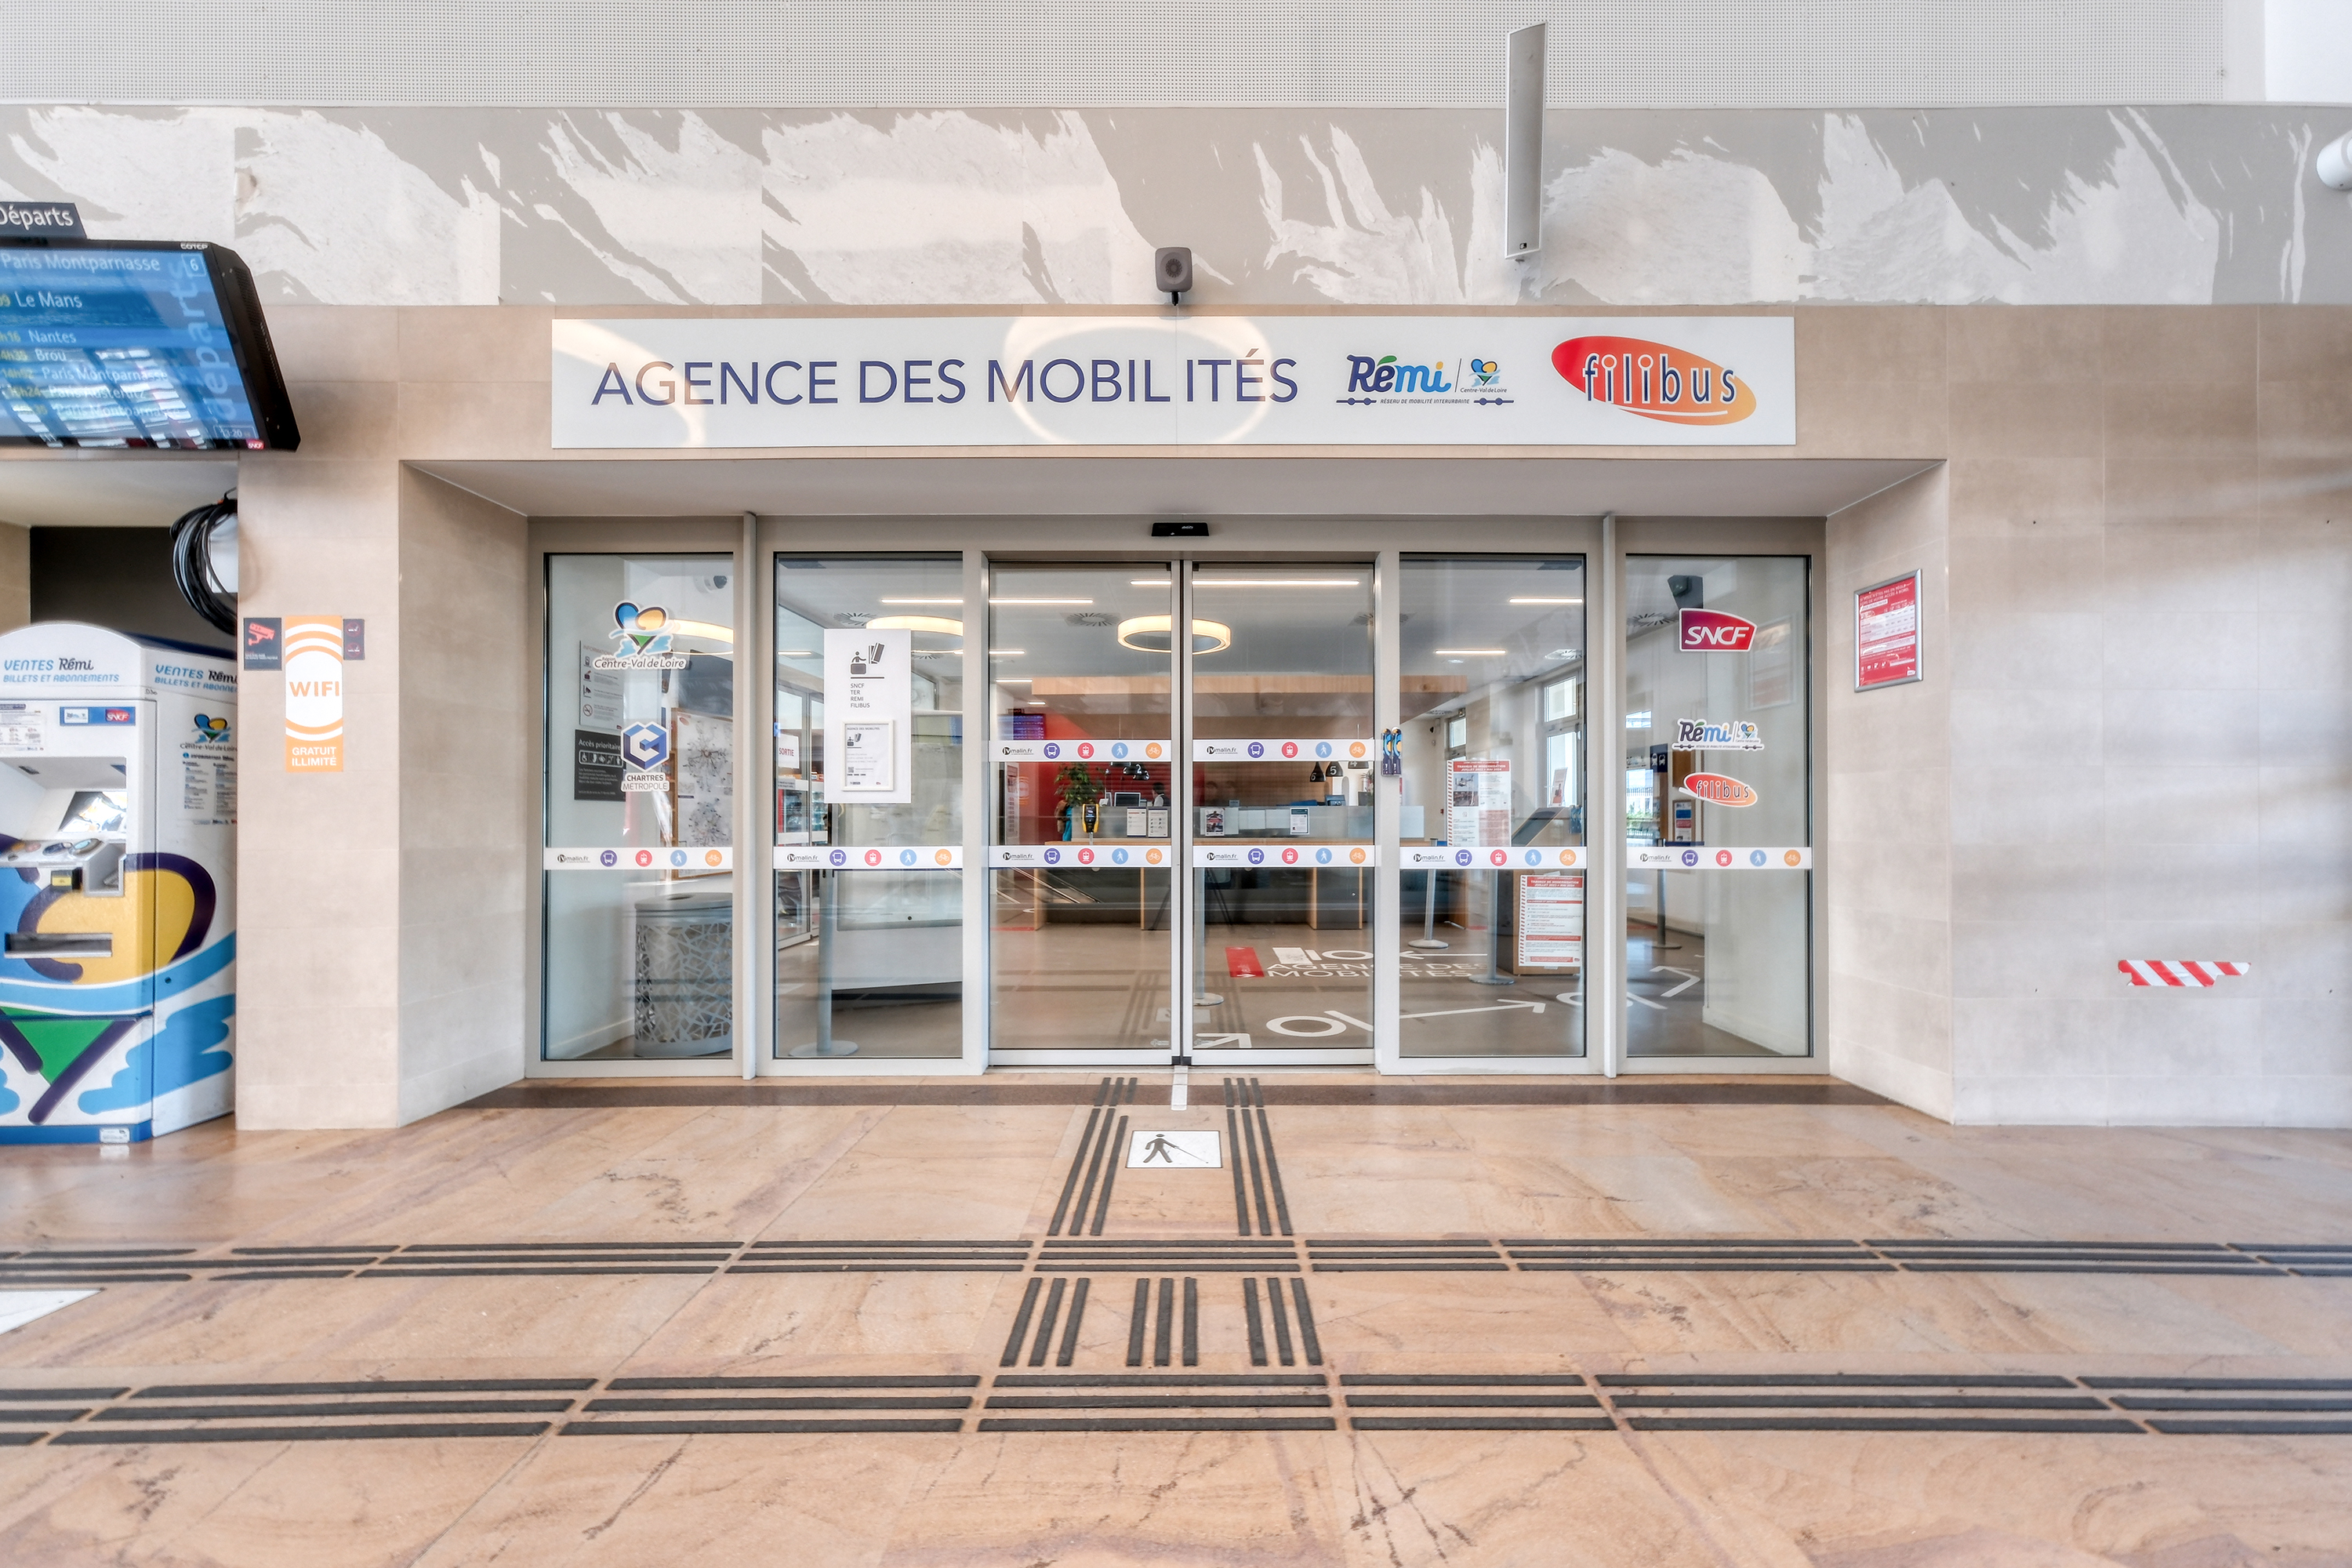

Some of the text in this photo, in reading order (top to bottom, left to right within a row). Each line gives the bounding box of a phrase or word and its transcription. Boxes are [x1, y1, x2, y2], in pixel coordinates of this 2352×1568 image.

[1, 252, 161, 273] Paris Montparnasse
[15, 291, 82, 308] Le Mans
[28, 329, 77, 343] Nantes
[42, 366, 75, 379] Paris
[591, 348, 1300, 406] AGENCE DES MOBILITÉS
[1346, 354, 1452, 393] Rémi
[1582, 352, 1737, 405] filibus
[1685, 626, 1750, 646] SNCF
[4, 657, 94, 671] VENTES Rémi
[594, 659, 646, 668] Centre-Val
[660, 658, 684, 668] Loire
[3, 673, 120, 683] BILLETS ET ABONNEMENTS
[155, 664, 204, 680] VENTES
[154, 676, 189, 688] BILLETS
[289, 681, 339, 698] WIFI
[107, 712, 129, 722] SNCF
[1679, 721, 1731, 742] Rémi
[292, 746, 336, 756] GRATUIT
[779, 747, 794, 757] SORTIE
[292, 755, 337, 767] ILLIMITÉ
[1135, 764, 1142, 774] 2
[1330, 766, 1338, 775] 5
[1697, 780, 1750, 798] filibus
